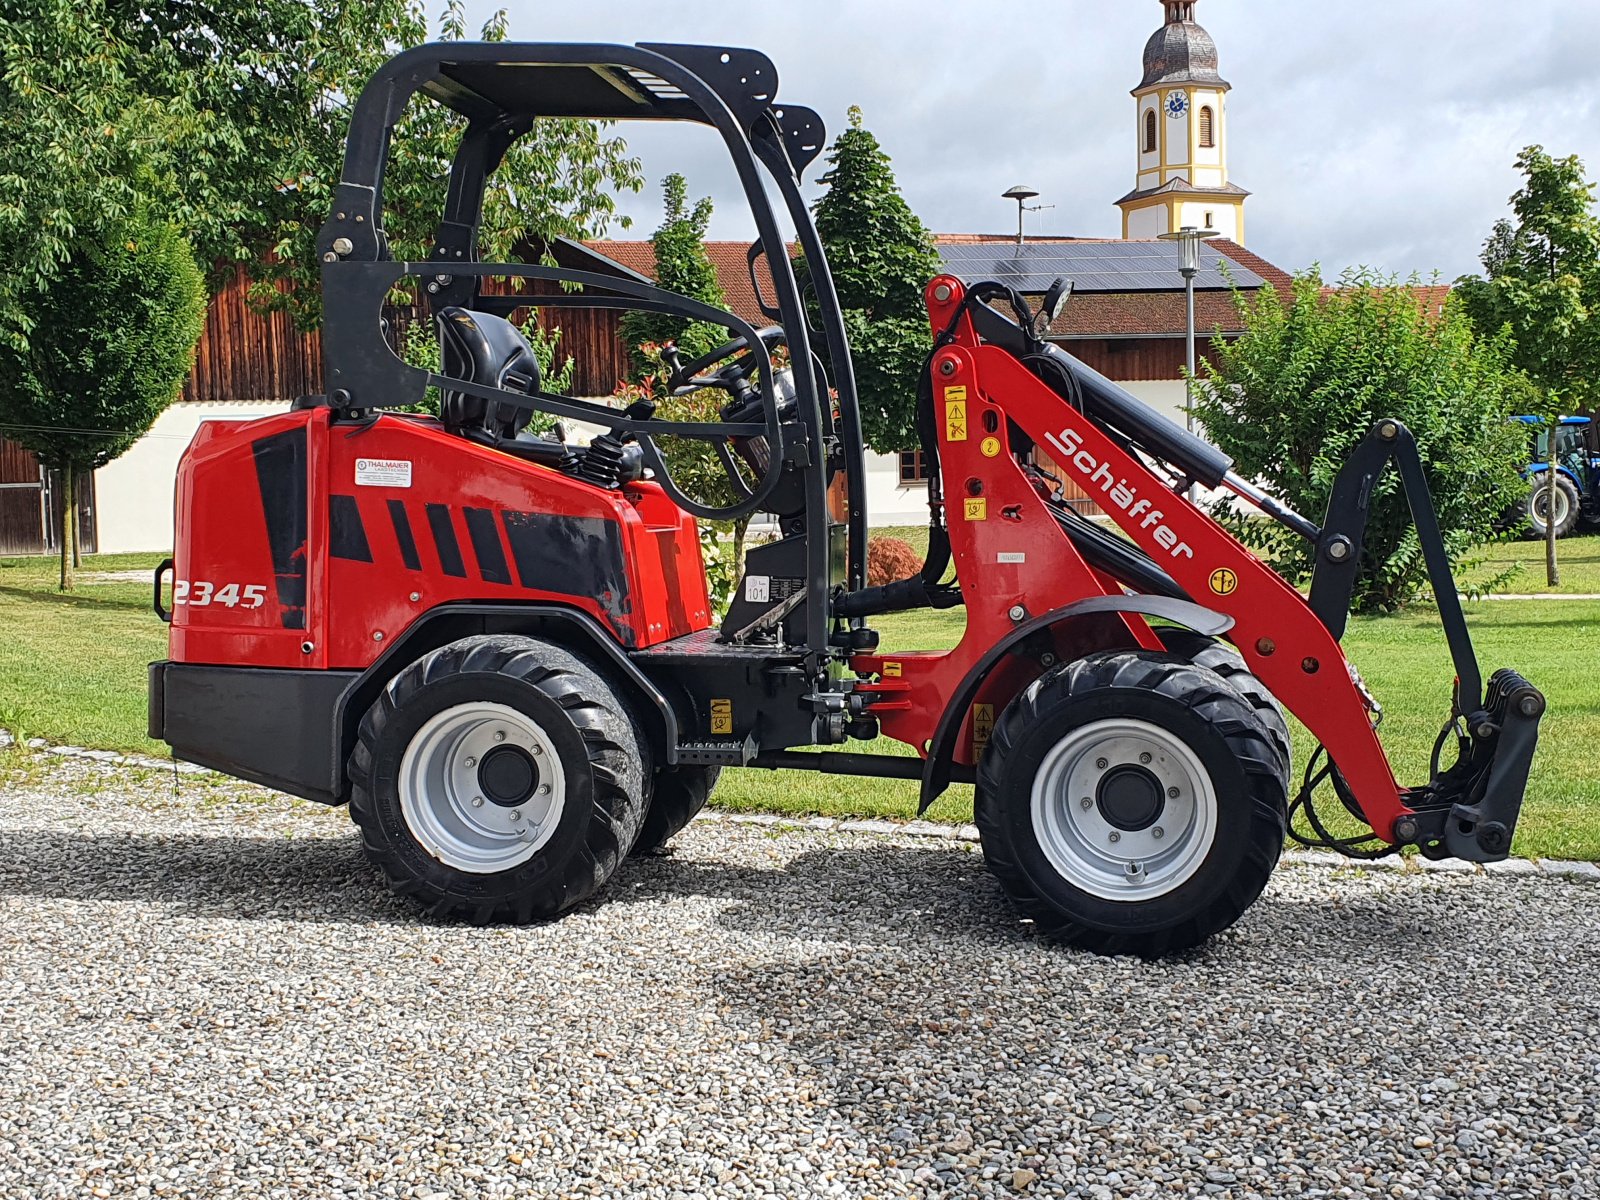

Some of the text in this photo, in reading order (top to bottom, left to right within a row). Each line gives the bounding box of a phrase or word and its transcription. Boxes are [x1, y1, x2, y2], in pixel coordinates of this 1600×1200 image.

[368, 461, 408, 469] THALMAIER
[1044, 428, 1193, 559] Schäffer
[173, 580, 267, 609] 2345
[749, 588, 763, 600] 101
